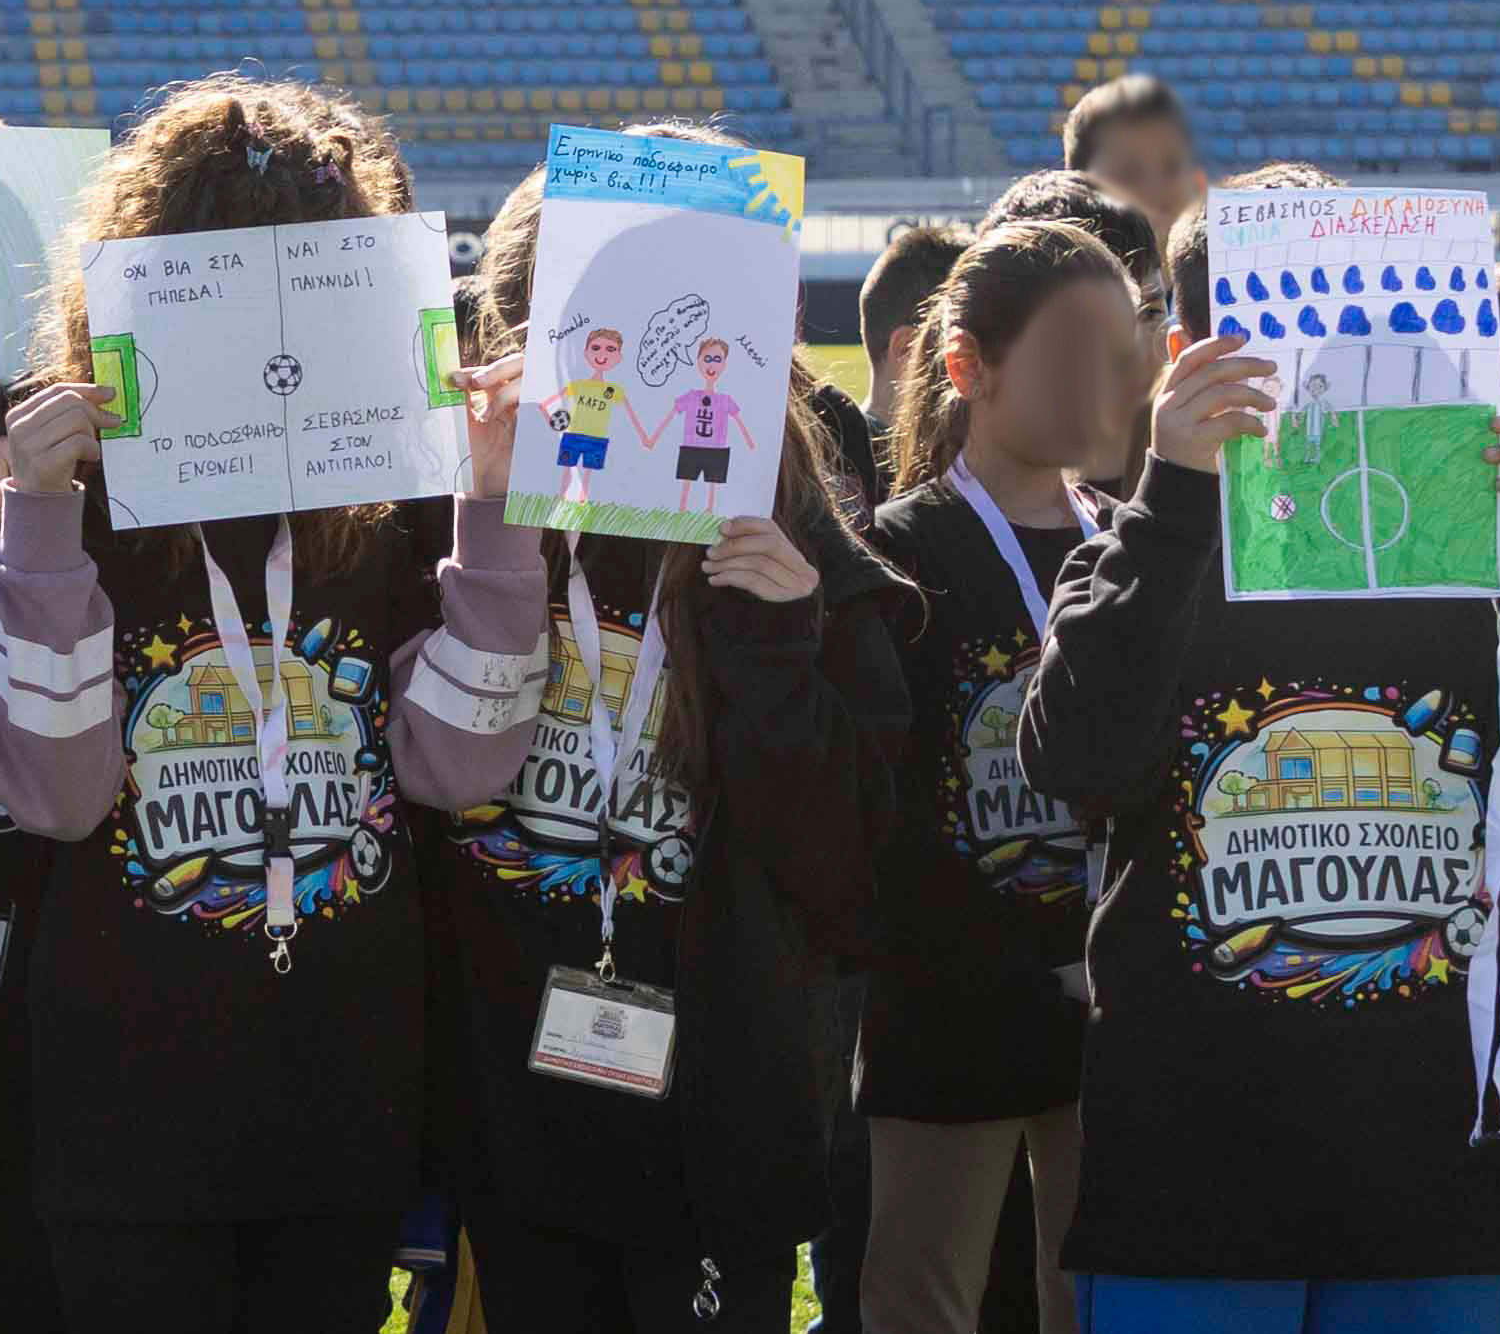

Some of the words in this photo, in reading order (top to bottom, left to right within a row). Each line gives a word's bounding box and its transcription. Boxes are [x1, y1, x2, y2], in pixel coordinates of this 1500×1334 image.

[1218, 199, 1337, 225] ΣΕΒΑΣΜΟΣ
[1352, 197, 1484, 216] ΔΙΚΑΙΟΣΥΝΗ
[1310, 216, 1435, 238] ΔΙΑΣΚΕΔΑΣΗ
[287, 240, 320, 260] ΝΑΙ
[340, 235, 376, 251] ΣΤΟ
[123, 264, 147, 280] ΟΧΙ
[164, 260, 191, 277] ΒΙΑ
[208, 253, 244, 269] ΣΤΑ
[302, 407, 403, 432] ΣΕΒΑΣΜΟΣ
[151, 437, 173, 454] ΤΟ
[285, 751, 347, 776] ΧΟΛΕΙΟ
[145, 780, 358, 850] ΜΑΓΟΛΑΣ
[1225, 822, 1351, 857] ΔΗΜΟΤΙΚΟ
[1358, 823, 1460, 851] ΣΧΟΛΕΙΟ
[1211, 855, 1471, 916] ΜΑΓΟΥΛΑΣ
